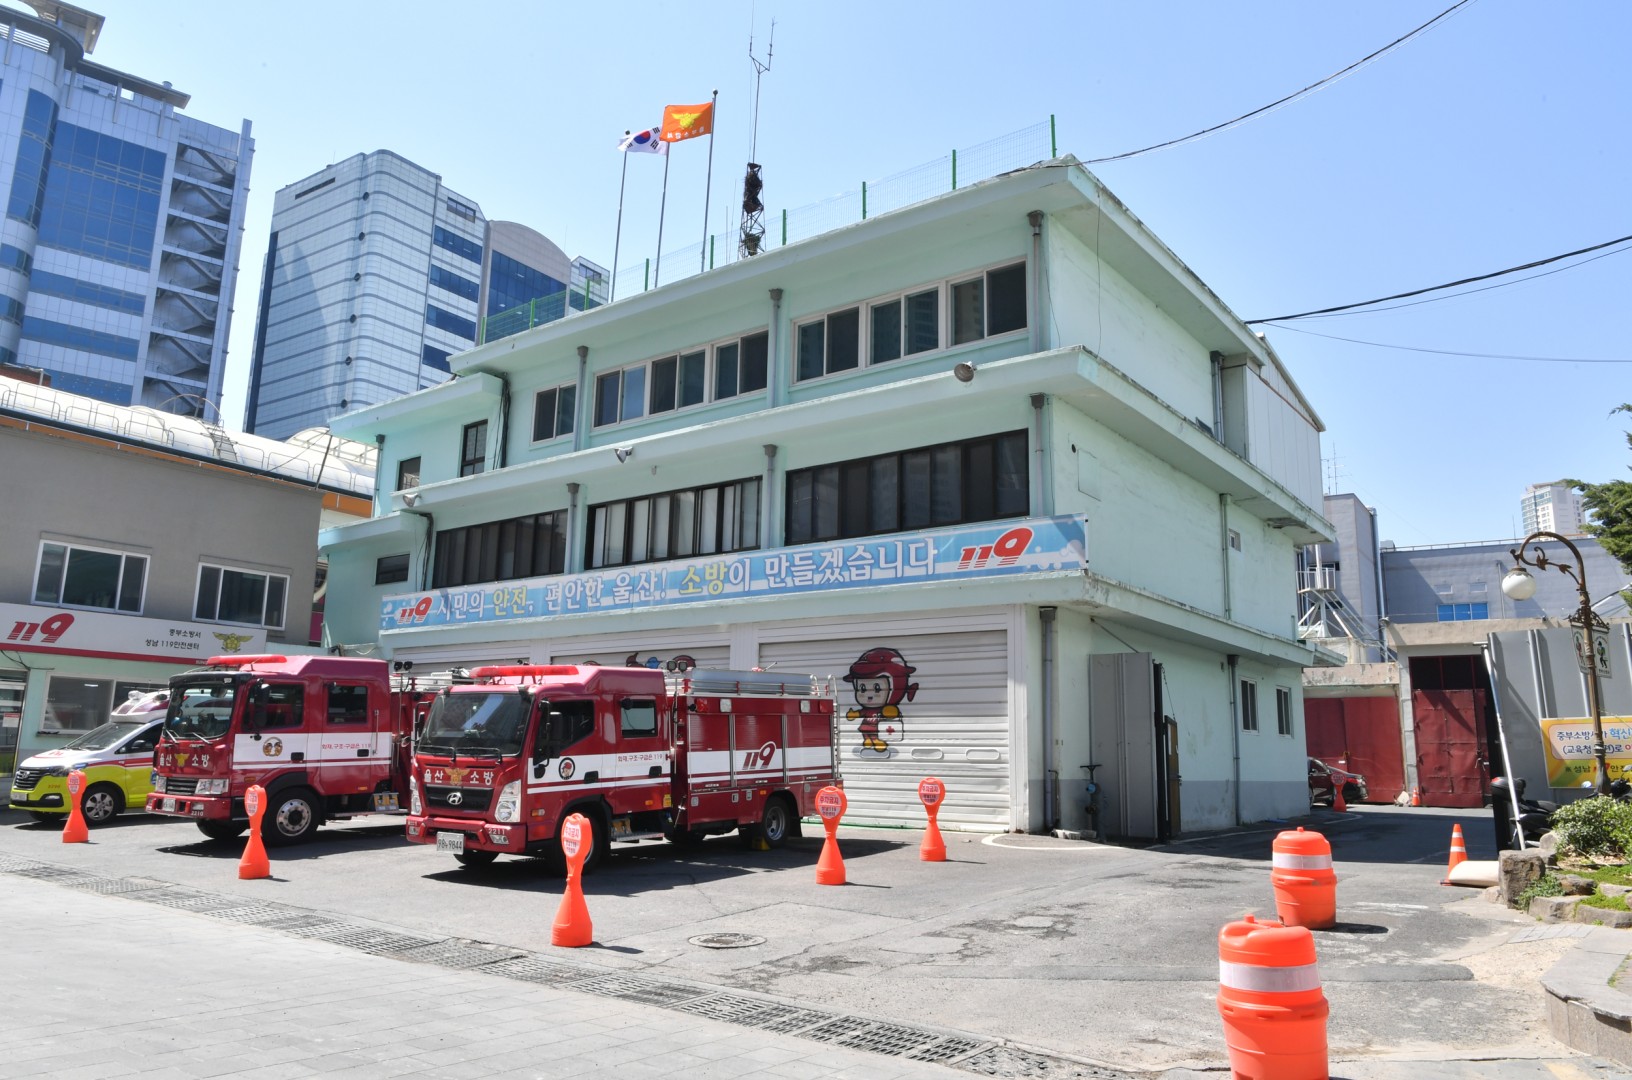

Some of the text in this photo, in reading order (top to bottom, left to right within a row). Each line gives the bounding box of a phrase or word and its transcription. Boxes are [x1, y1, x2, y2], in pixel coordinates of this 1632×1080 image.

[397, 527, 1034, 624] 119 시민의 안전, 편안한 울산! 소방이 만들겠습니다 119
[7, 612, 75, 643] 119
[169, 628, 202, 639] 중부소방서
[145, 638, 159, 647] 성남
[1556, 730, 1607, 741] 중부소방
[192, 753, 210, 768] 소방
[741, 741, 777, 771] 119
[424, 768, 494, 786] 울산 소방
[488, 828, 505, 836] 2211
